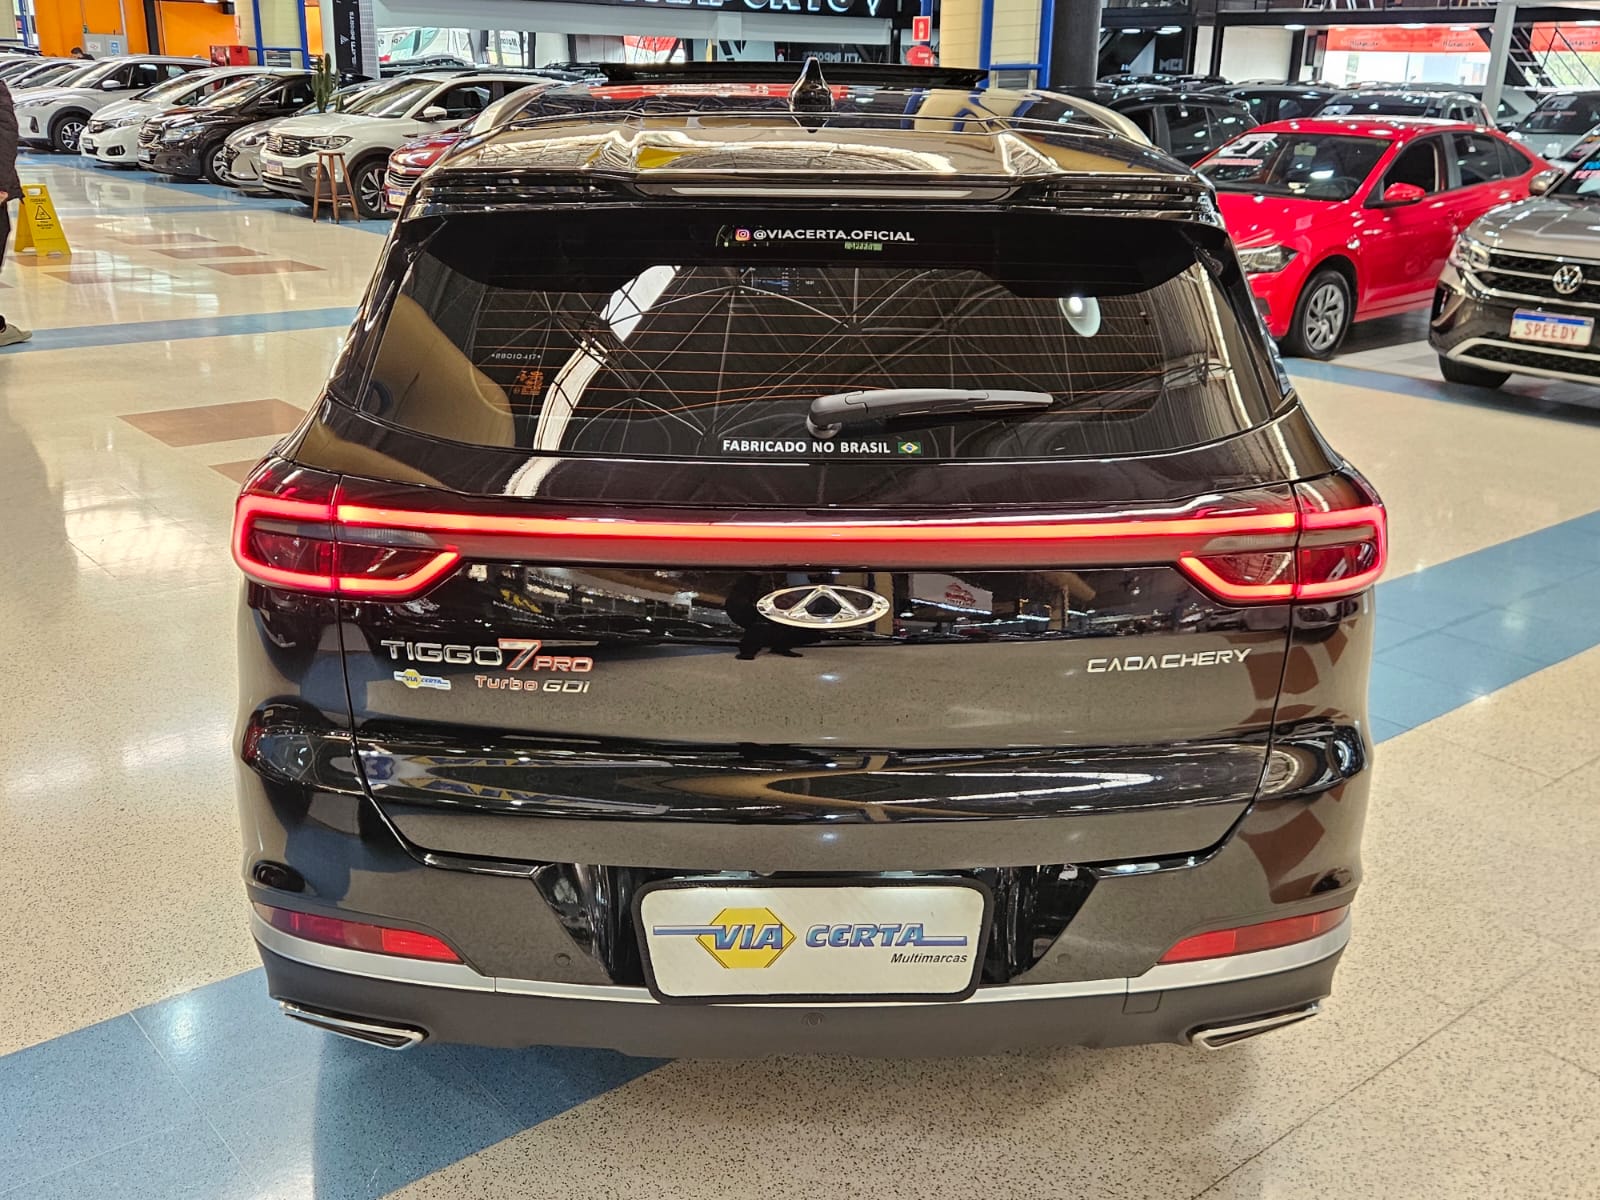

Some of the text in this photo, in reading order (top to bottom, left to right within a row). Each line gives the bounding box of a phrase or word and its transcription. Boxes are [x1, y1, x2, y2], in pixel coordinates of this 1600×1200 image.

[753, 228, 915, 242] @VIACERTA.OFICIAL
[1524, 322, 1578, 340] SPEEDY
[722, 439, 891, 454] FABRICADO NO BRASIL
[380, 639, 503, 666] TIGGO
[533, 655, 594, 673] PRO
[474, 674, 591, 693] Turbo GDI
[713, 922, 925, 950] VIA CERTA
[890, 952, 968, 964] Multimarcas
